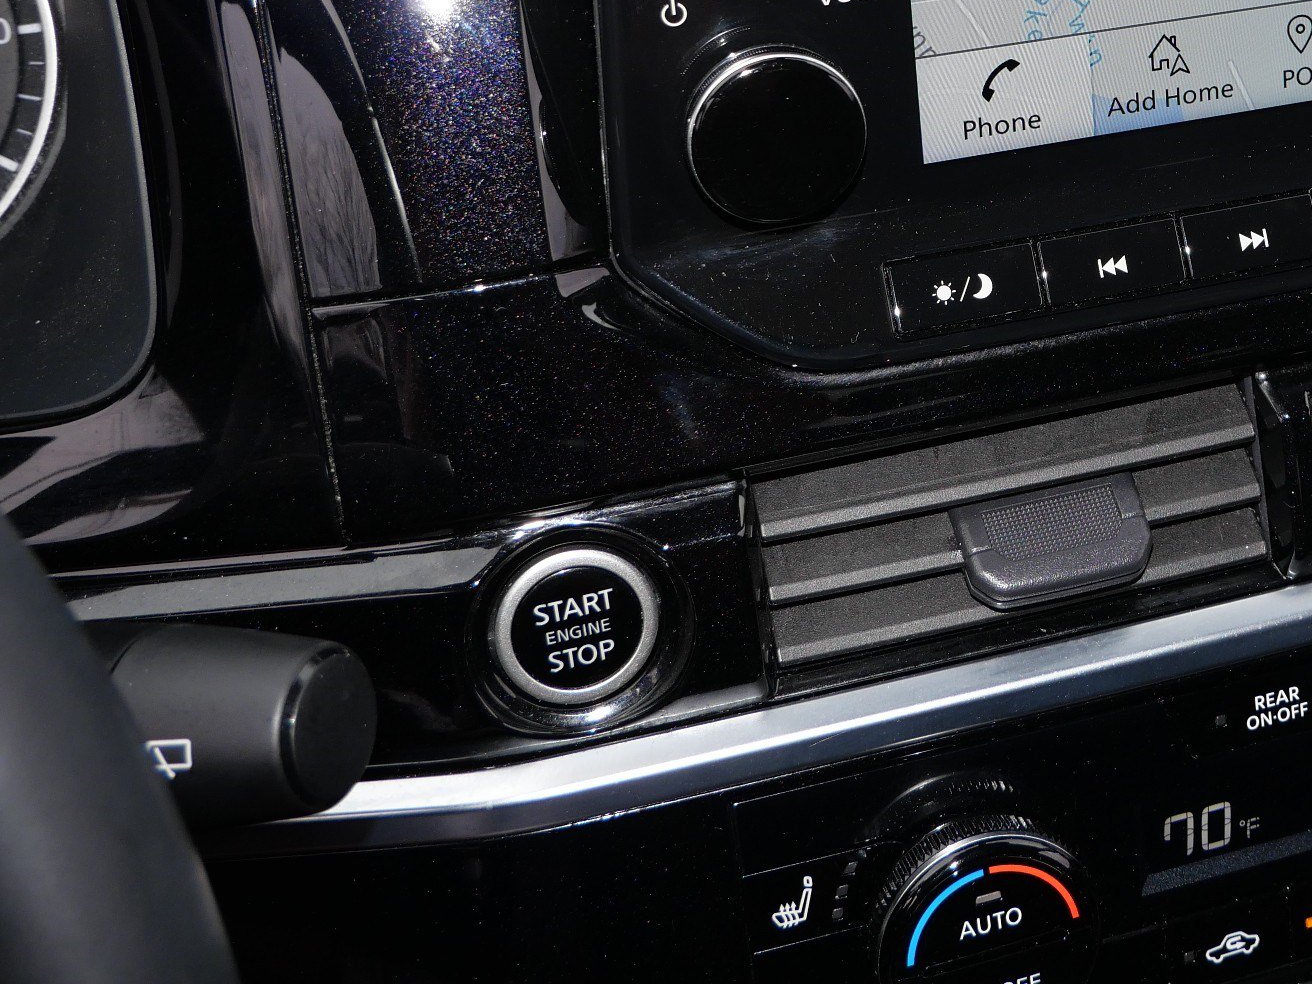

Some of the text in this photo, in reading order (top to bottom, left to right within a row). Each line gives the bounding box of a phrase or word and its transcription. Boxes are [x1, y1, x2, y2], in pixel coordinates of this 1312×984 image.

[1107, 80, 1235, 116] Add Home
[962, 111, 1042, 140] Phone
[533, 588, 613, 627] START
[545, 618, 612, 646] ENGINE
[548, 638, 615, 673] STOP
[1254, 685, 1301, 711] REAR
[959, 905, 1024, 942] AUTO
